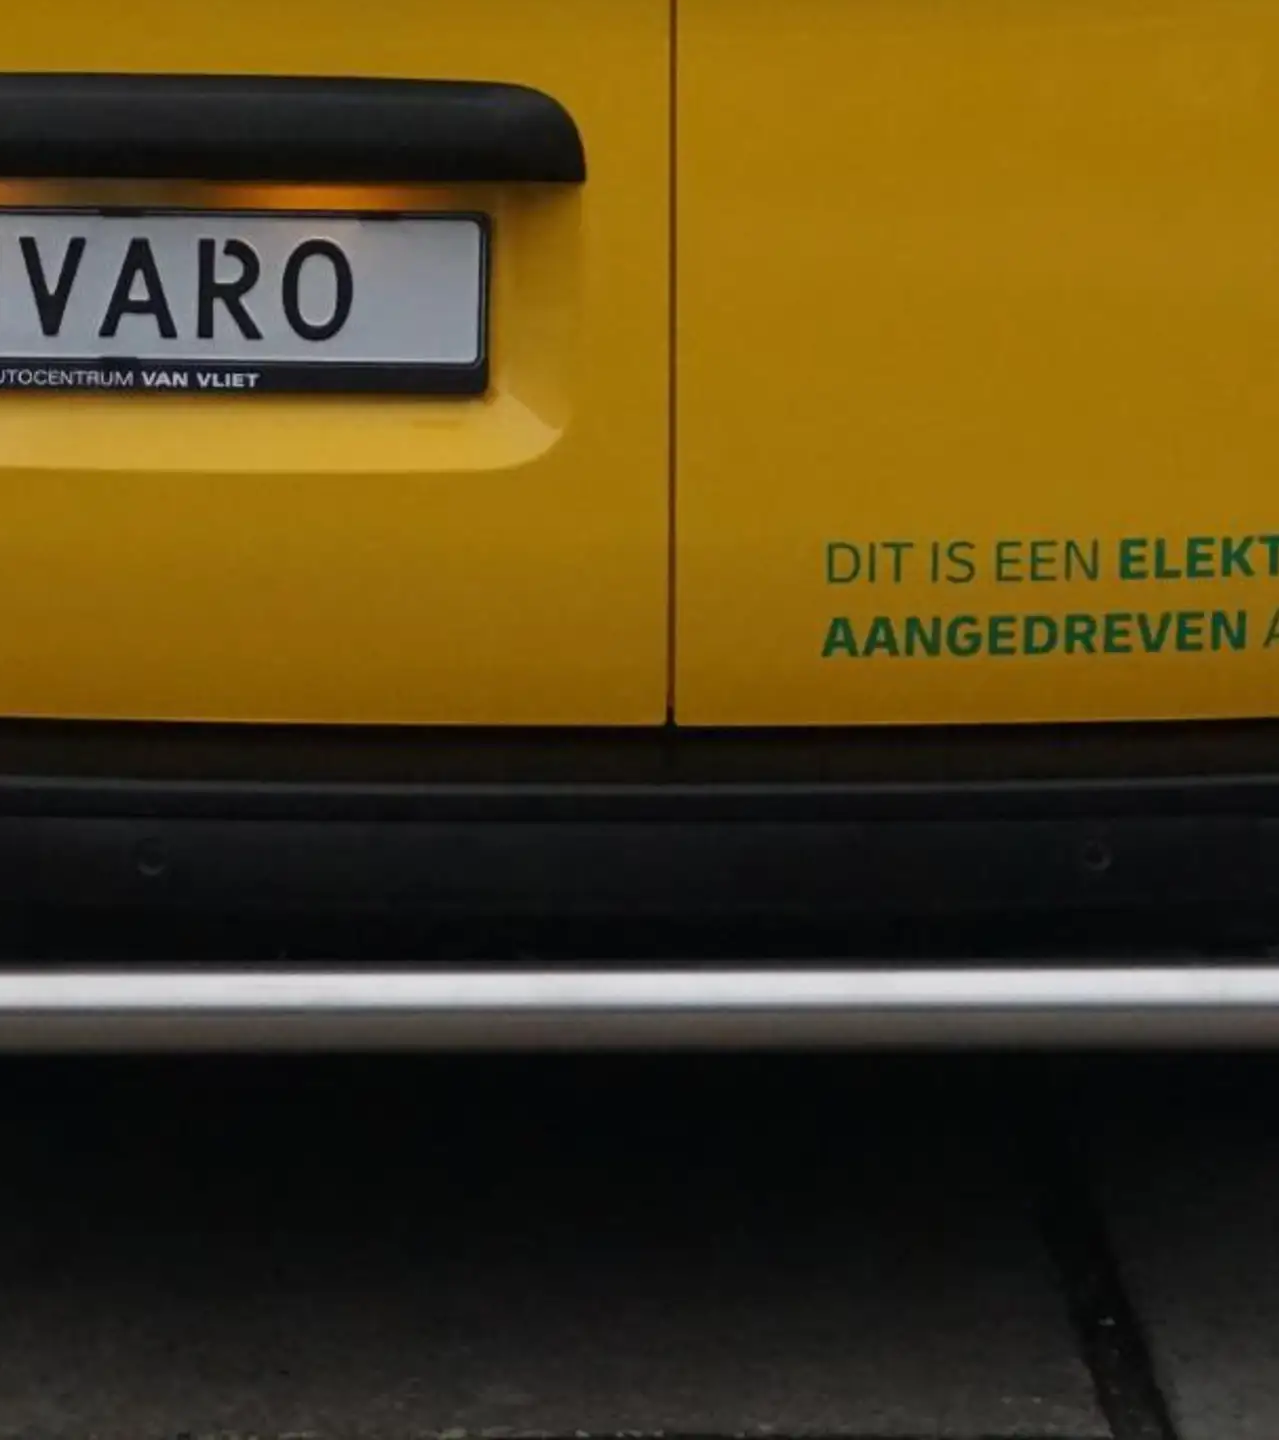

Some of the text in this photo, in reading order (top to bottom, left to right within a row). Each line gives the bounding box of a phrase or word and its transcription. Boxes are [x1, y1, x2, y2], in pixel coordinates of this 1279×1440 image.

[141, 370, 189, 388] VAN
[196, 372, 261, 389] VLIET
[826, 542, 914, 584] DIT
[931, 541, 976, 584] IS
[996, 539, 1099, 582] EEN
[821, 610, 1247, 658] AANGEDREVEN
